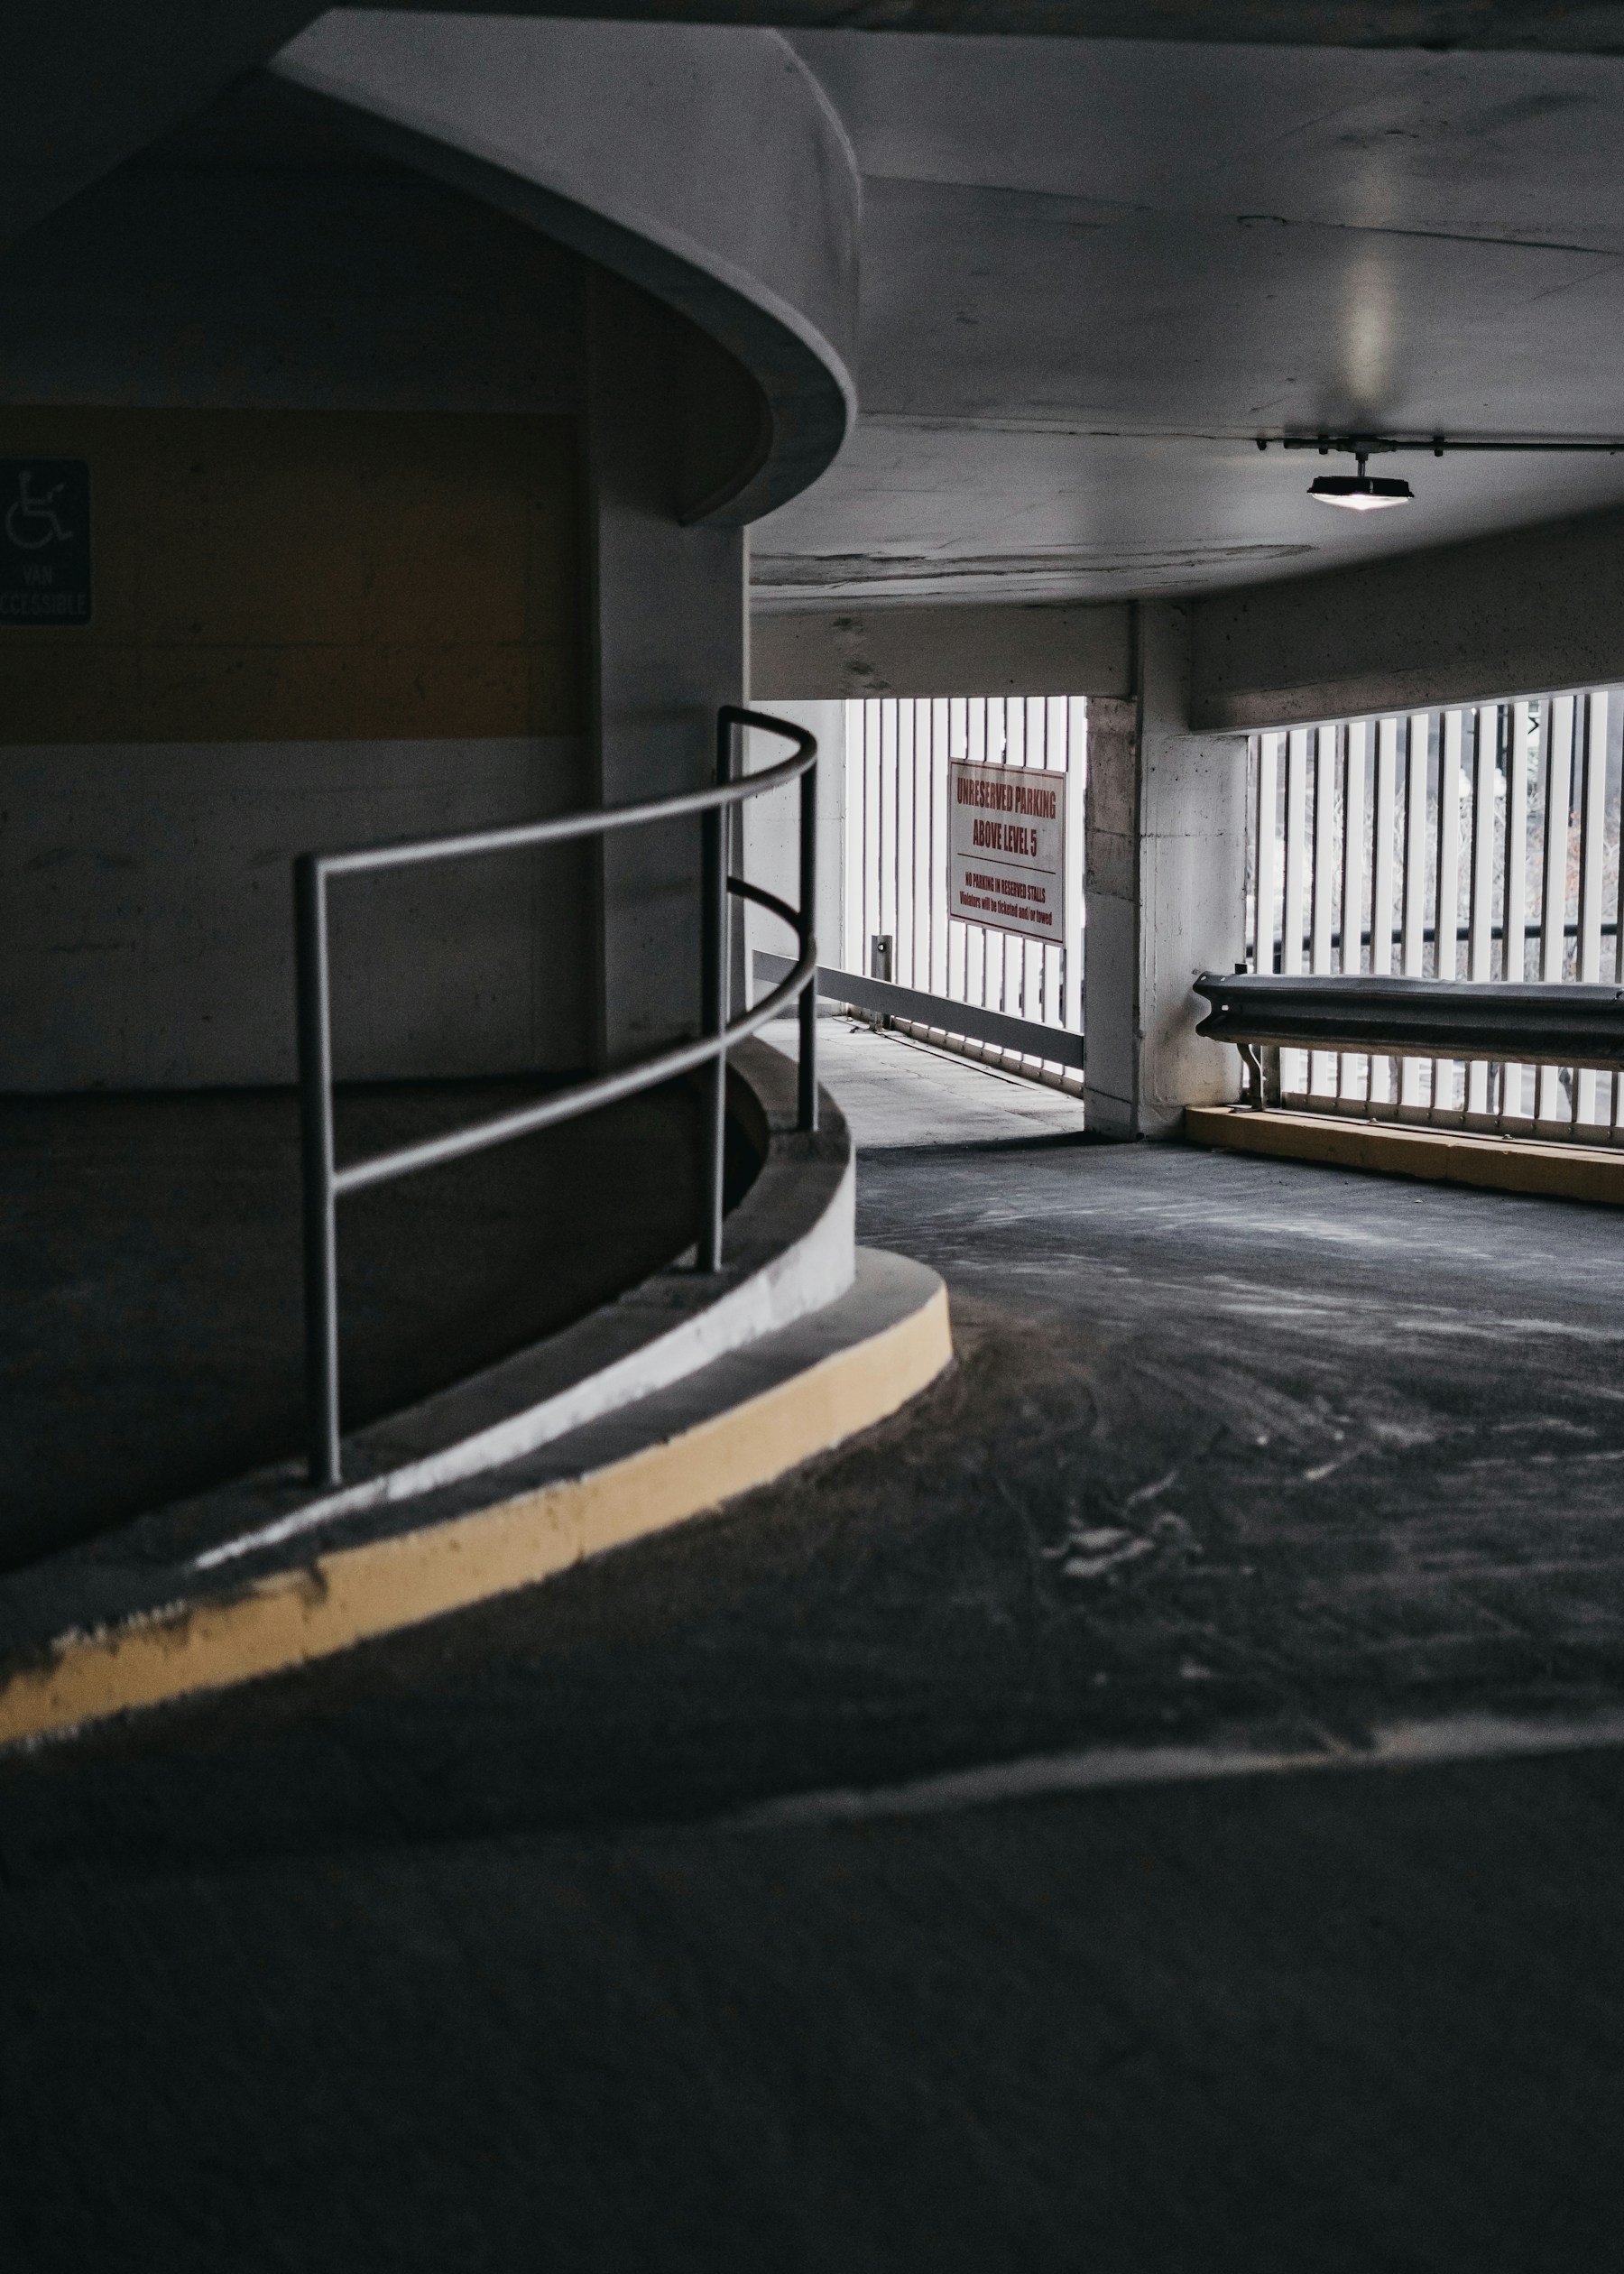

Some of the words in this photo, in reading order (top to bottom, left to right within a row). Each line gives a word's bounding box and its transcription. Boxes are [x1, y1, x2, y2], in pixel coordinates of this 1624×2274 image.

[23, 563, 52, 585] VAN
[0, 592, 87, 615] CCESSIBLE
[957, 778, 1012, 811] UNRESERVED
[1015, 786, 1056, 819] PARKING
[973, 818, 1001, 850] ABOVE
[1003, 824, 1028, 855] LEVEL
[1030, 829, 1037, 857] 5
[965, 872, 972, 886] NO
[973, 874, 993, 892] PARKING
[995, 878, 1001, 892] IN
[1001, 880, 1026, 899] RESERVED
[1028, 885, 1045, 903] STALLS
[960, 891, 980, 908] Violators
[982, 897, 990, 911] will
[992, 898, 996, 912] be
[998, 901, 1018, 917] ticketed
[1019, 905, 1035, 921] and/or
[1037, 910, 1052, 925] towed
